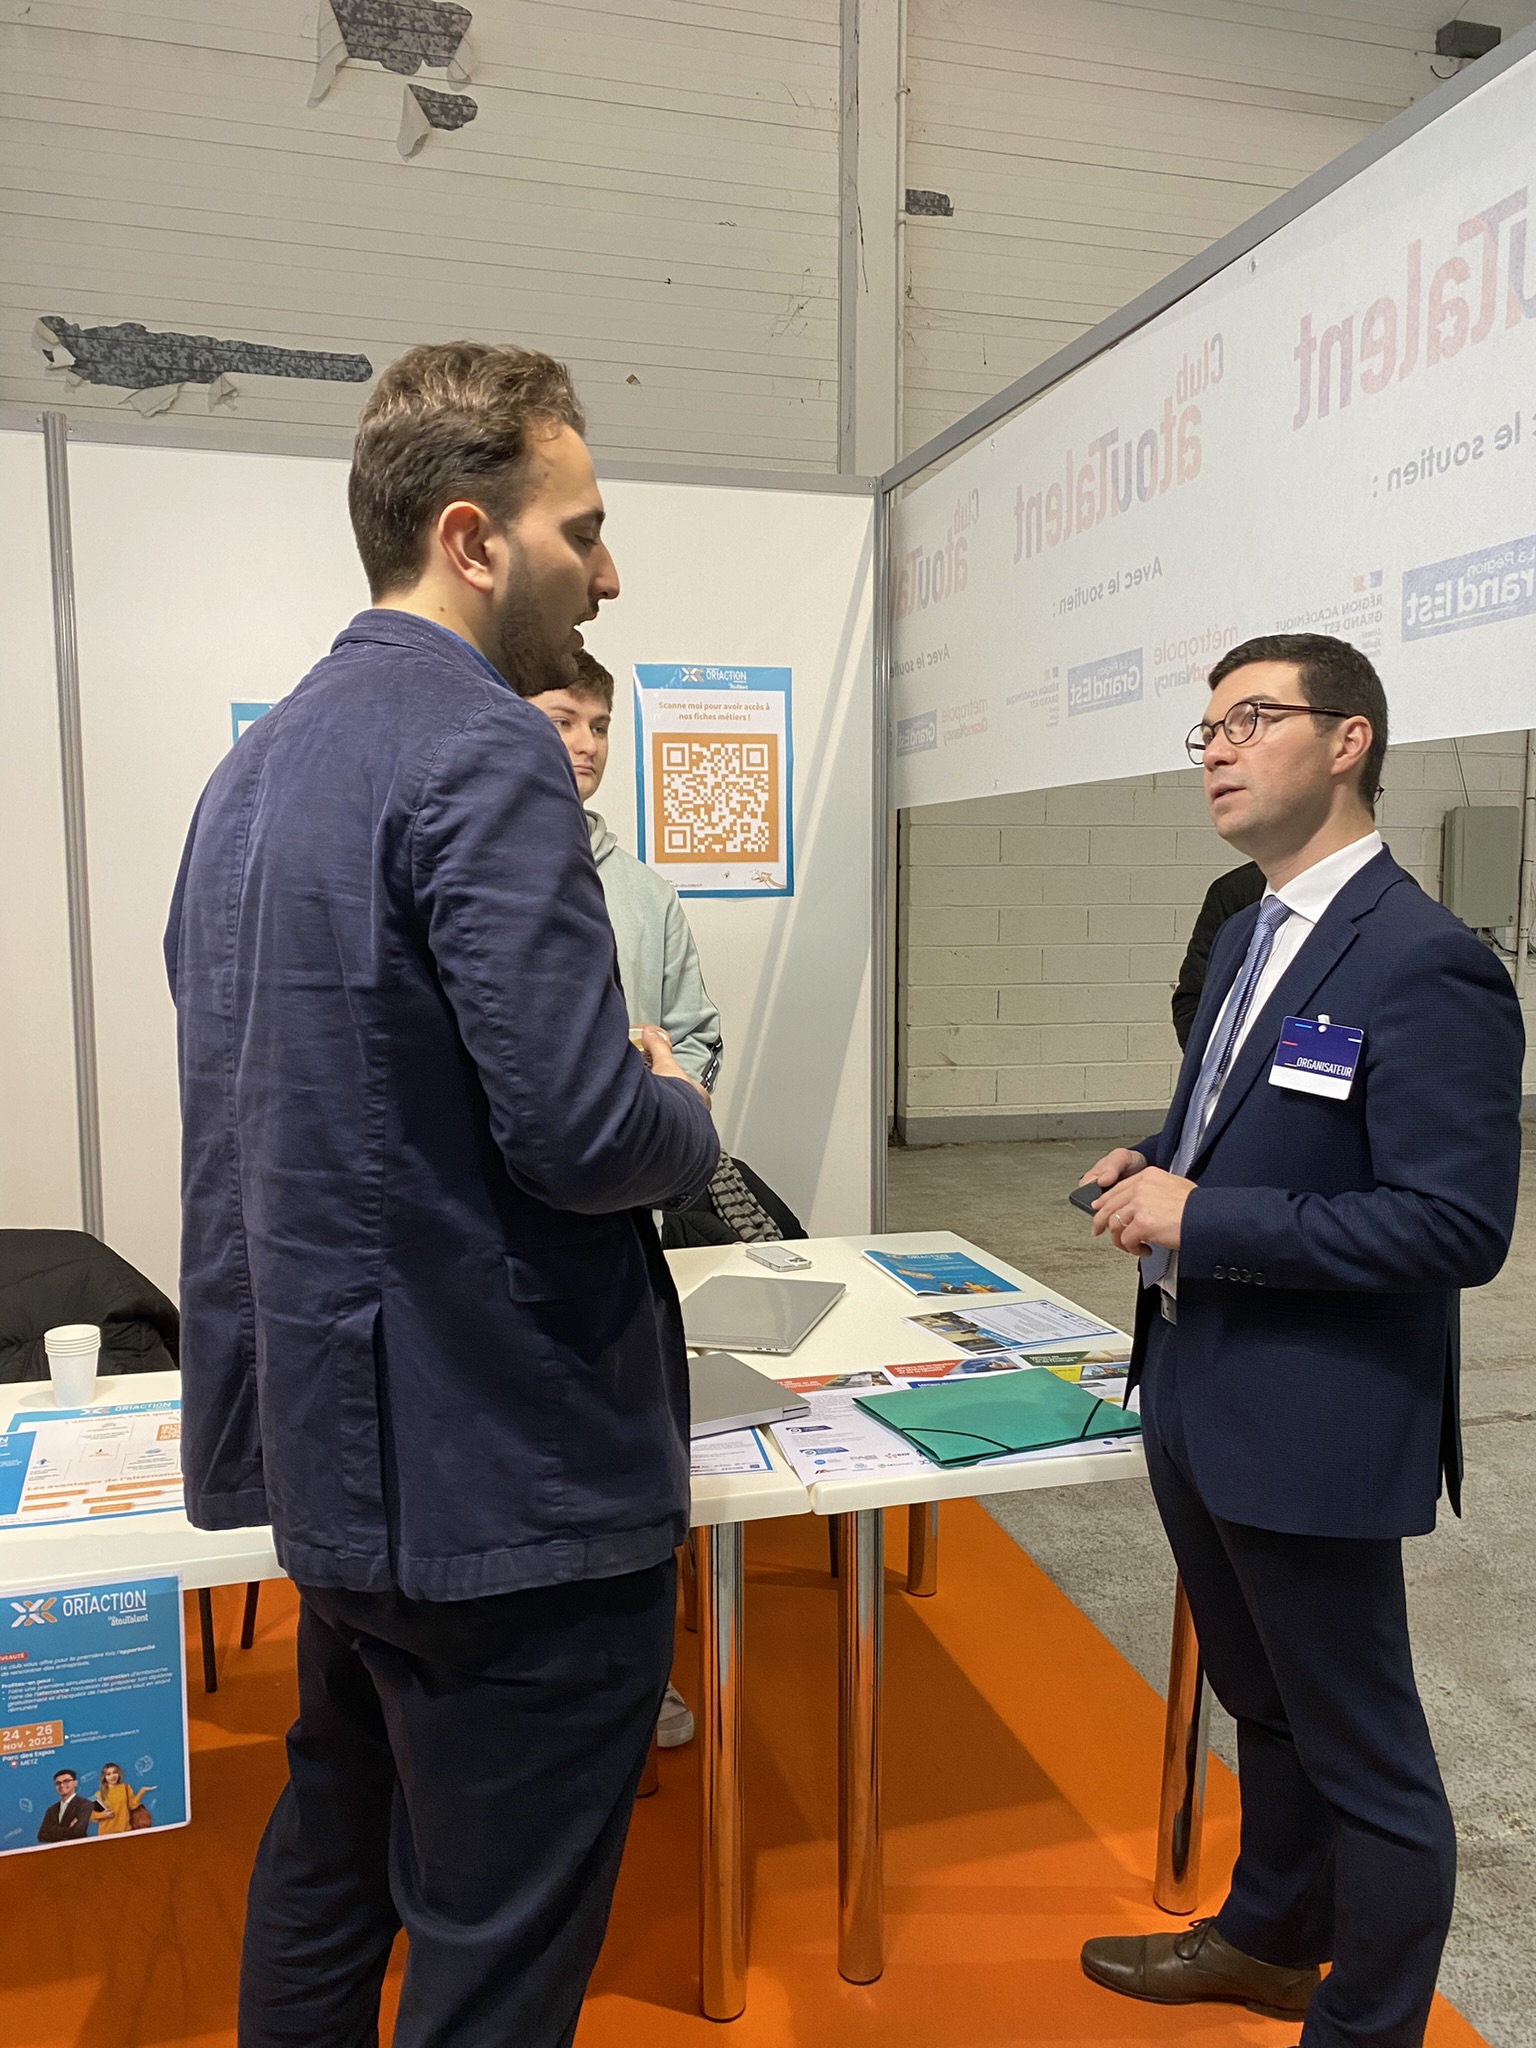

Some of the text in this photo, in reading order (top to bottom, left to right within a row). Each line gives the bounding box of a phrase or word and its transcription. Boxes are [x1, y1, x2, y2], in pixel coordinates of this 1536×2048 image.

[706, 669, 747, 682] ORIACTION
[658, 702, 687, 710] Scanne
[688, 702, 703, 710] moi
[704, 703, 722, 711] pour
[744, 702, 764, 711] accès
[765, 702, 770, 711] à
[694, 713, 717, 721] fiches
[718, 713, 747, 721] métiers
[1296, 1057, 1353, 1077] ORGANISATEUR
[114, 1401, 172, 1412] ORIACTION
[63, 1590, 147, 1617] ORIACTION
[0, 1652, 25, 1662] VEAUTÉ
[3, 1724, 53, 1742] 24 26
[3, 1735, 53, 1751] NOV. 2022
[2, 1748, 56, 1763] Parc des Expos
[20, 1758, 38, 1767] METZ
